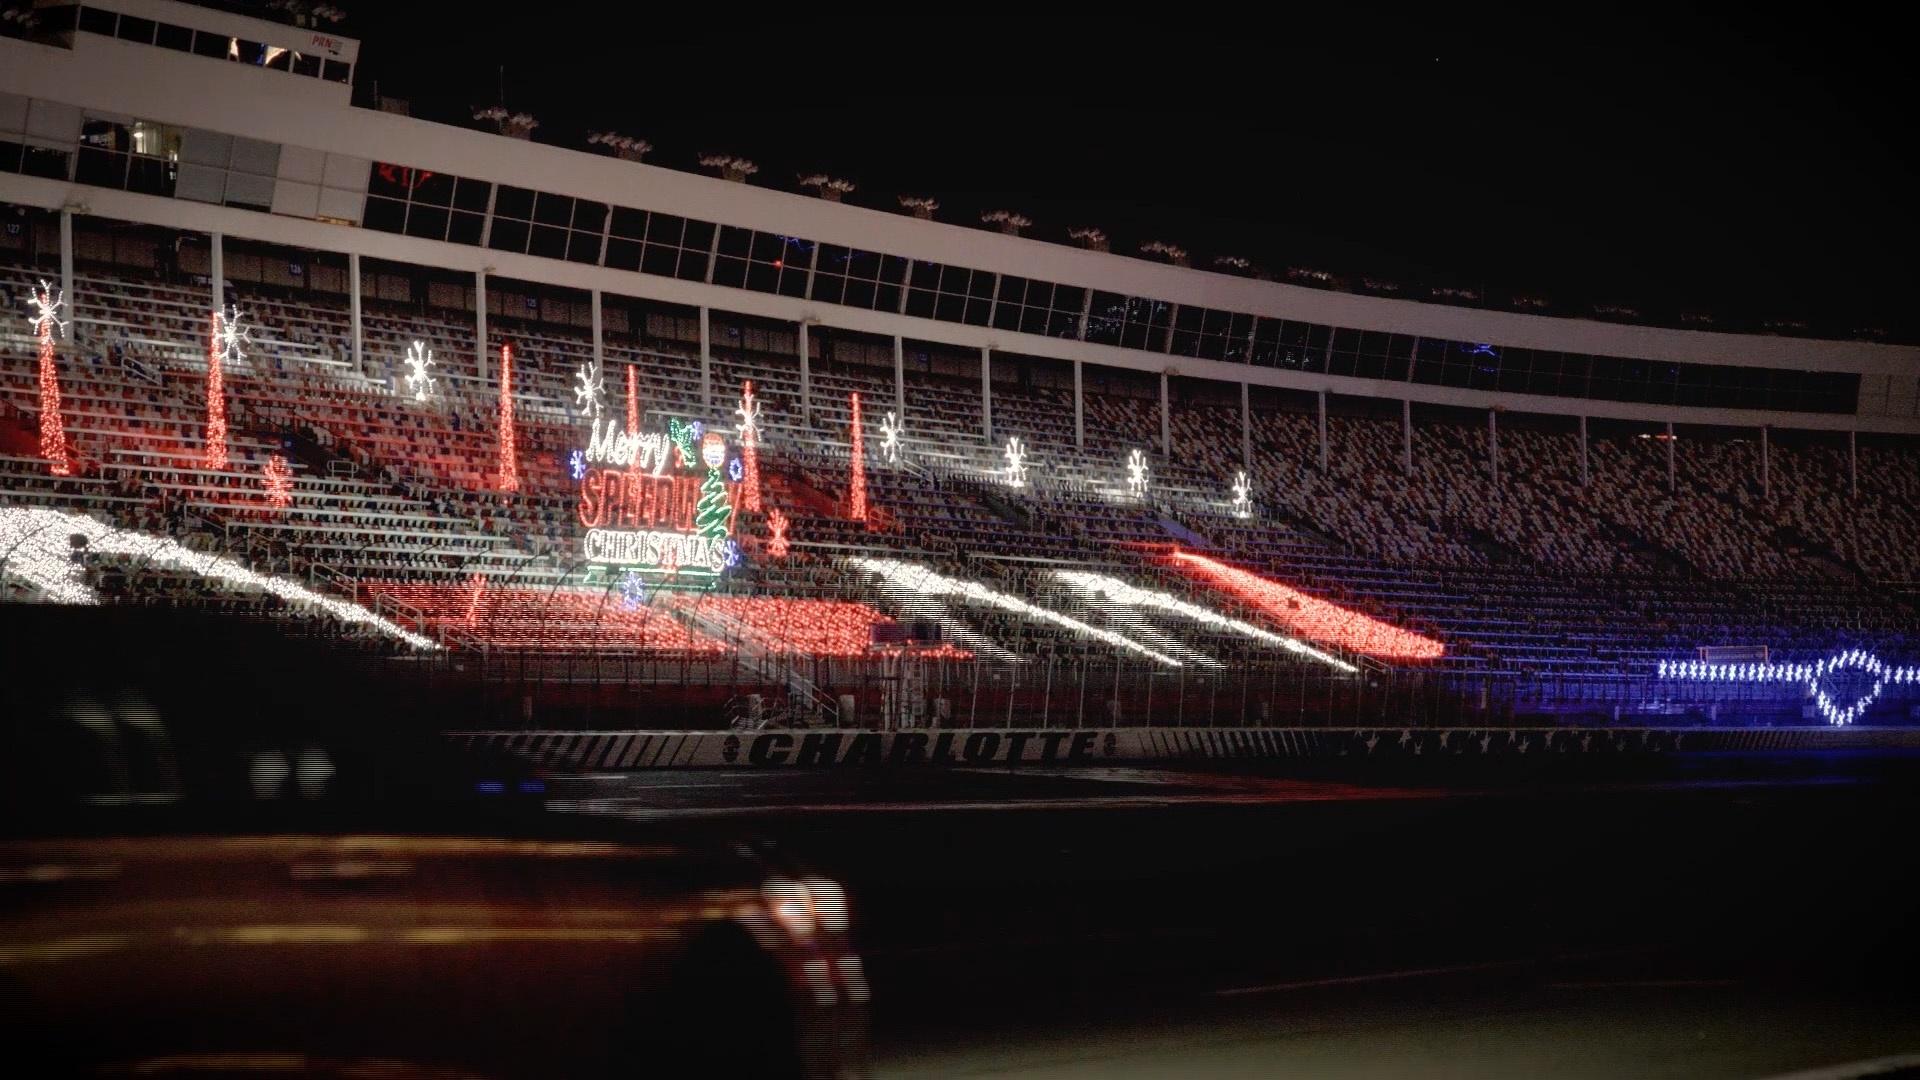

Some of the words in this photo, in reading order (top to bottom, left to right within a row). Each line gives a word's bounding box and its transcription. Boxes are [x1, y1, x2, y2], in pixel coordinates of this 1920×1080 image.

[312, 35, 333, 48] PRN
[586, 418, 670, 477] Merry
[584, 529, 726, 572] CHRISTMAS
[749, 732, 1098, 768] CHARLOTTE
